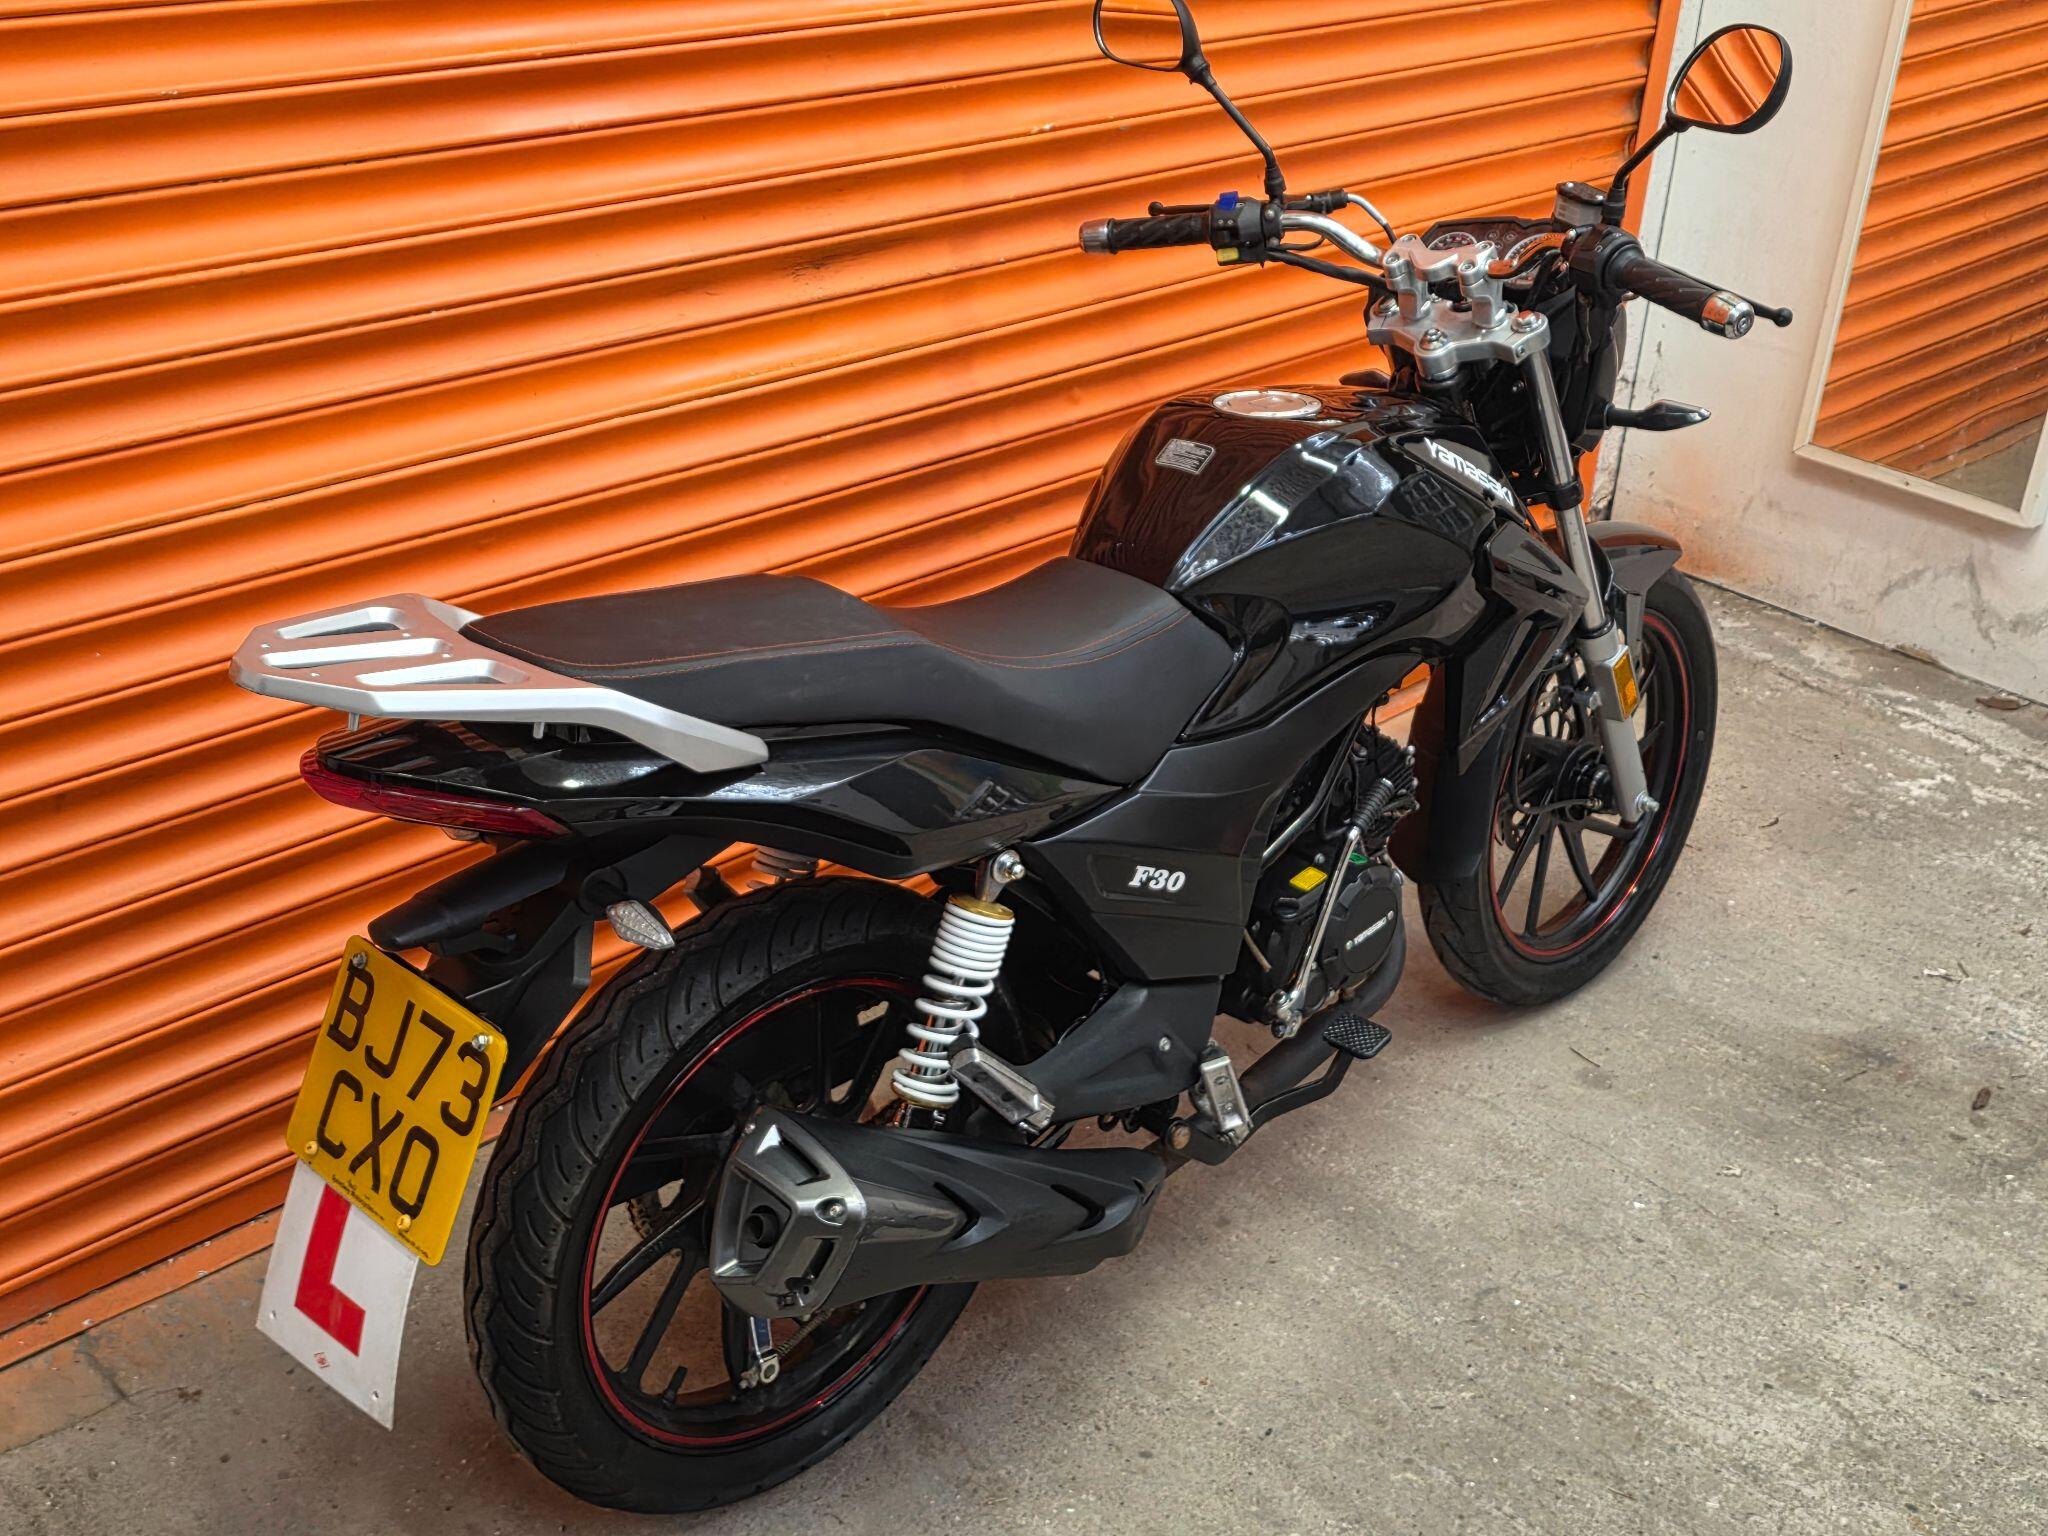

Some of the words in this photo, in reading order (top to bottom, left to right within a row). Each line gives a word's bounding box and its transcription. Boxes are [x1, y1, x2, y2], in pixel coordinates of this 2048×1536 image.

[1128, 865, 1186, 892] F30
[327, 960, 490, 1137] BJ73
[317, 1069, 440, 1221] CXO
[294, 1182, 366, 1358] L
